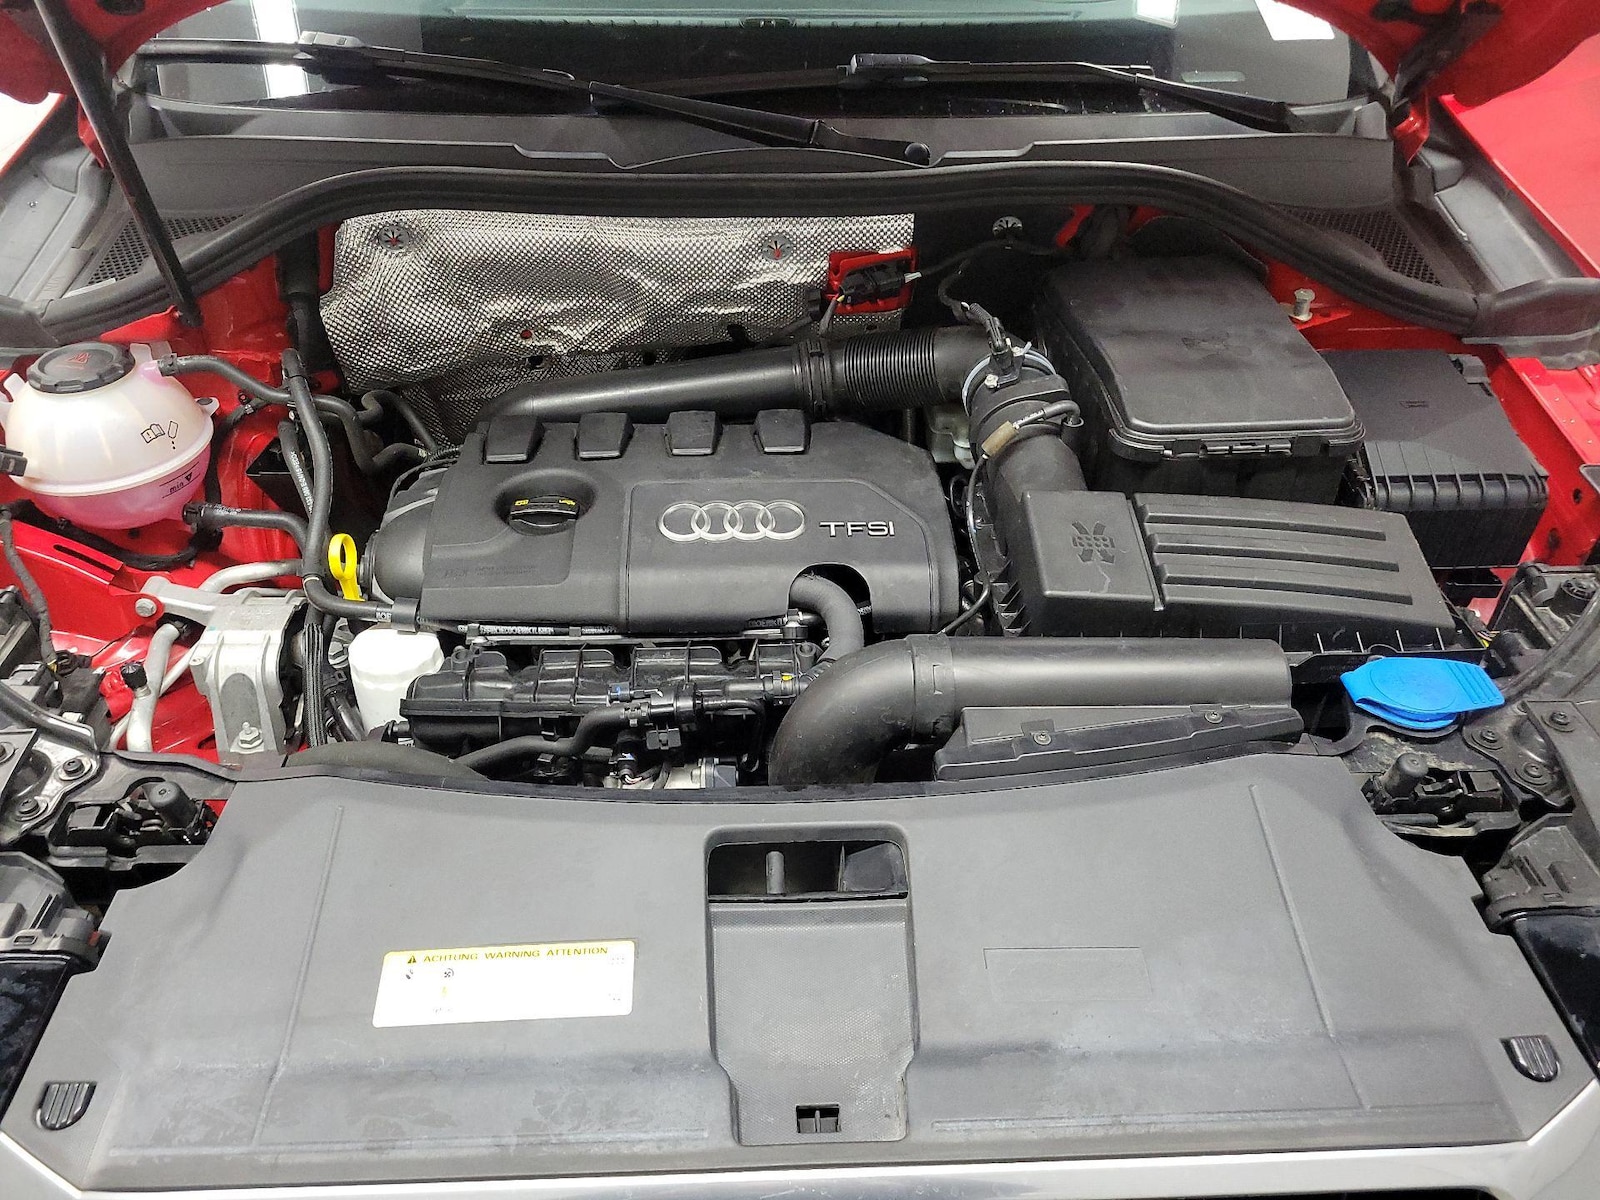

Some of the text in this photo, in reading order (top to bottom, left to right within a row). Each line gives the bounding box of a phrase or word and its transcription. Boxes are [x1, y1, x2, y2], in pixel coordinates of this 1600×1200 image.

[169, 481, 184, 493] min
[819, 520, 895, 537] TFSI
[423, 946, 608, 963] ACHTUNG WARNING ATTENTION
